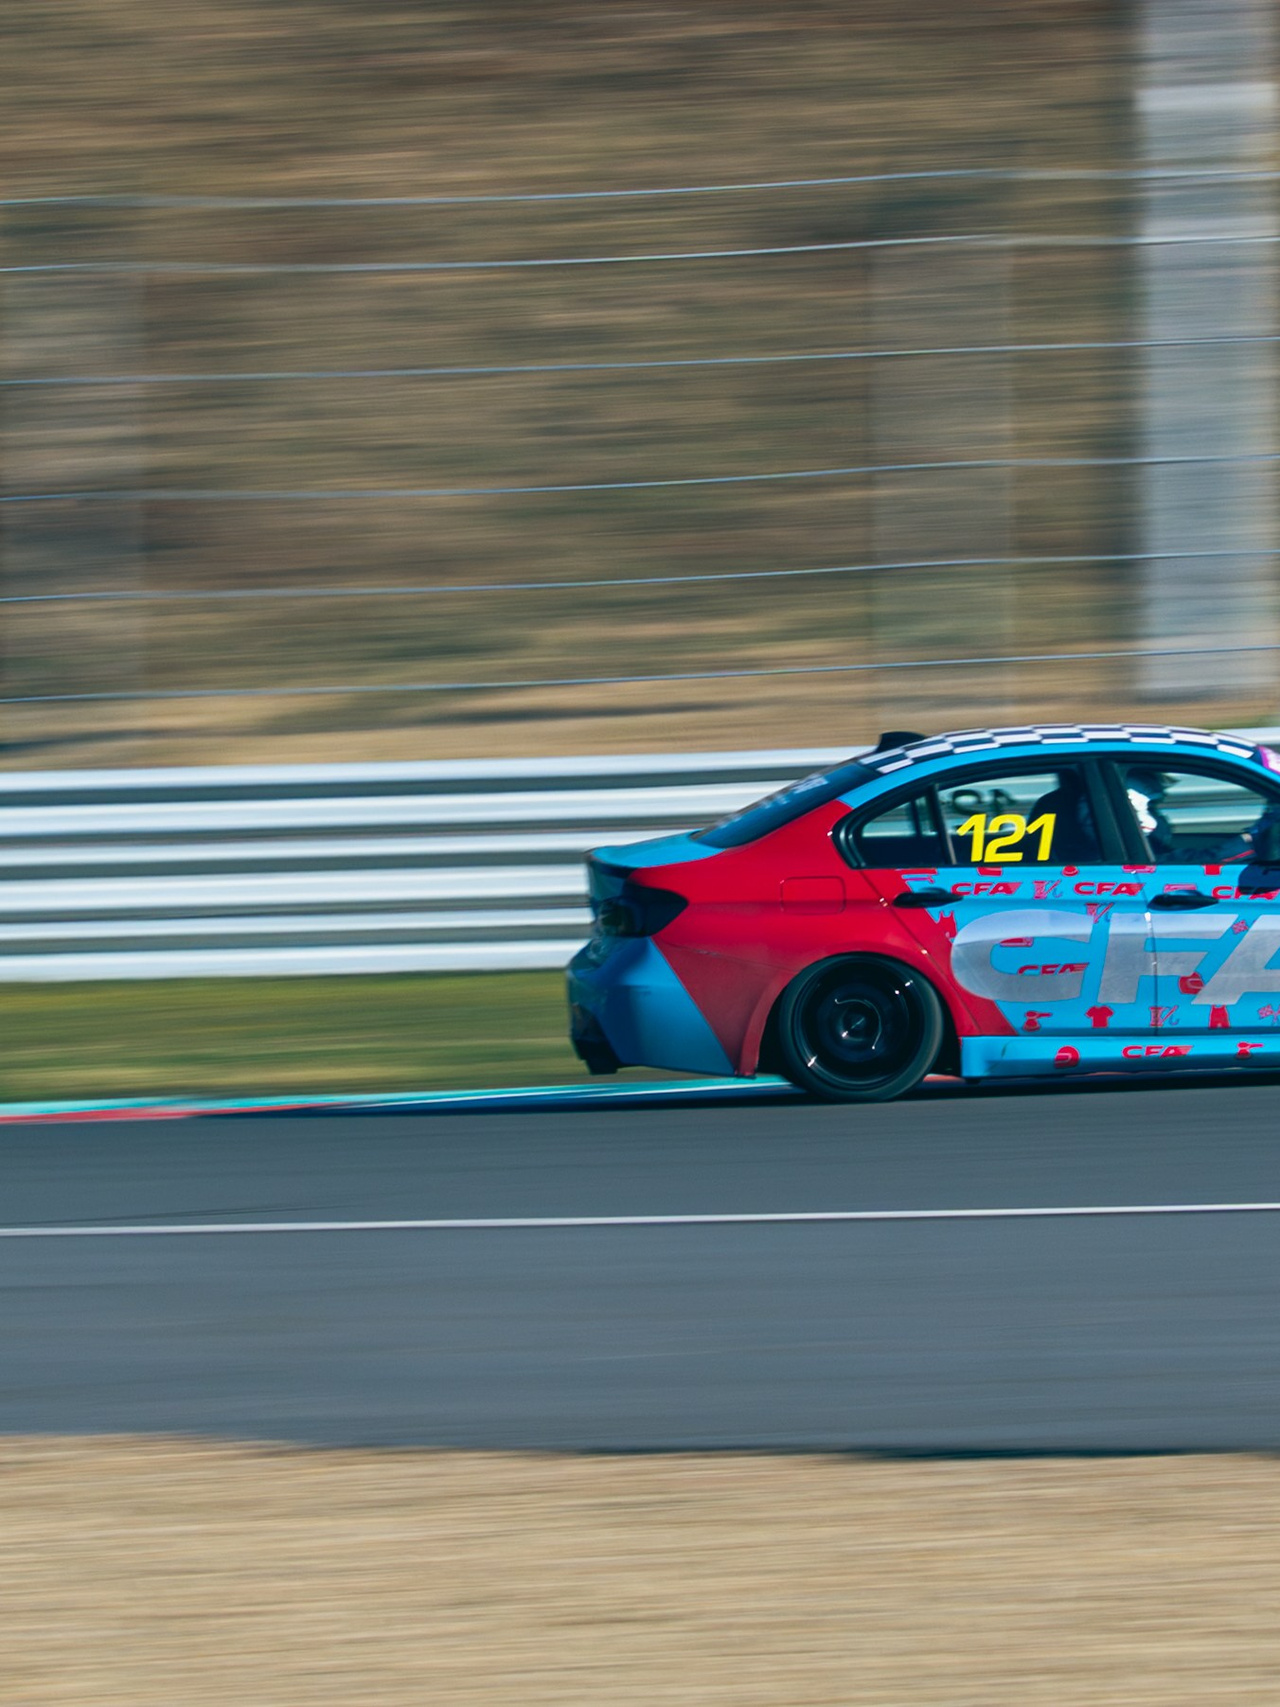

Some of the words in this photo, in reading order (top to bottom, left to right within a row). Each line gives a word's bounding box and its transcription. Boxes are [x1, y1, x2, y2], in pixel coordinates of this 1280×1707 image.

[957, 813, 1056, 862] 121
[950, 881, 1023, 896] CFA
[1074, 881, 1145, 896] CFA
[1122, 1045, 1193, 1059] CFA
